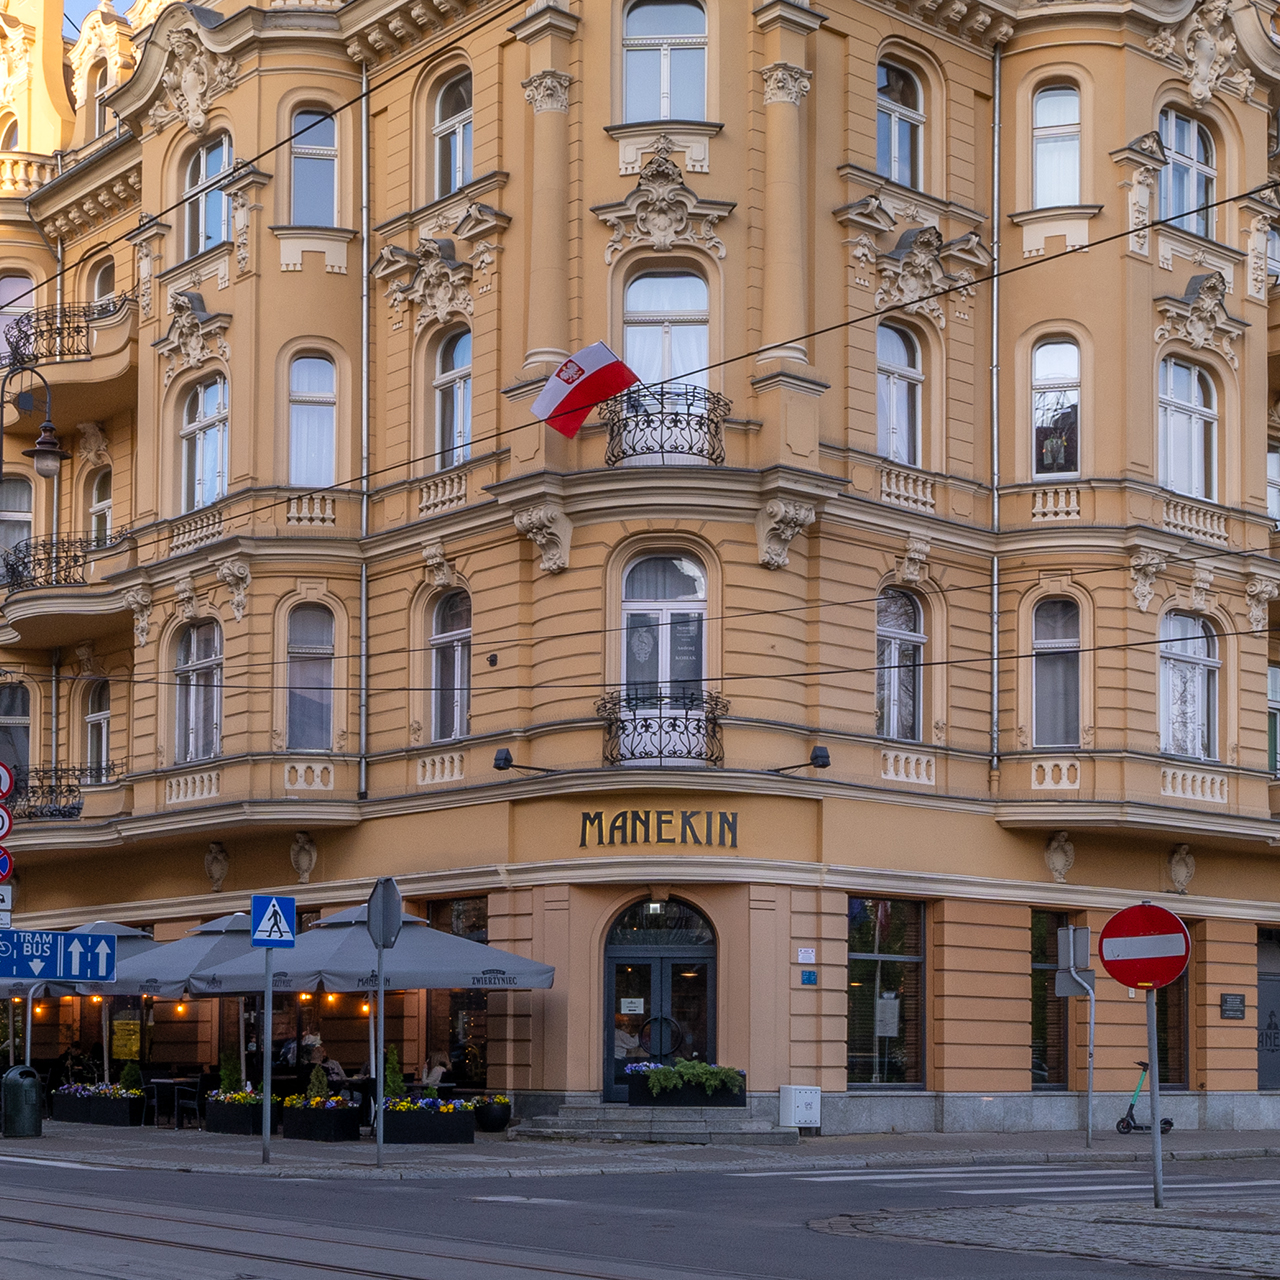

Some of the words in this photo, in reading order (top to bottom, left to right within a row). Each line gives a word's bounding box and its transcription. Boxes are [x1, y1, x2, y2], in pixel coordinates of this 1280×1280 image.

[579, 810, 738, 848] MANEKIN
[19, 932, 53, 943] TRAM
[23, 943, 51, 956] BUS
[357, 976, 391, 988] MANEIN
[471, 976, 518, 986] ZWIERZYNIEC
